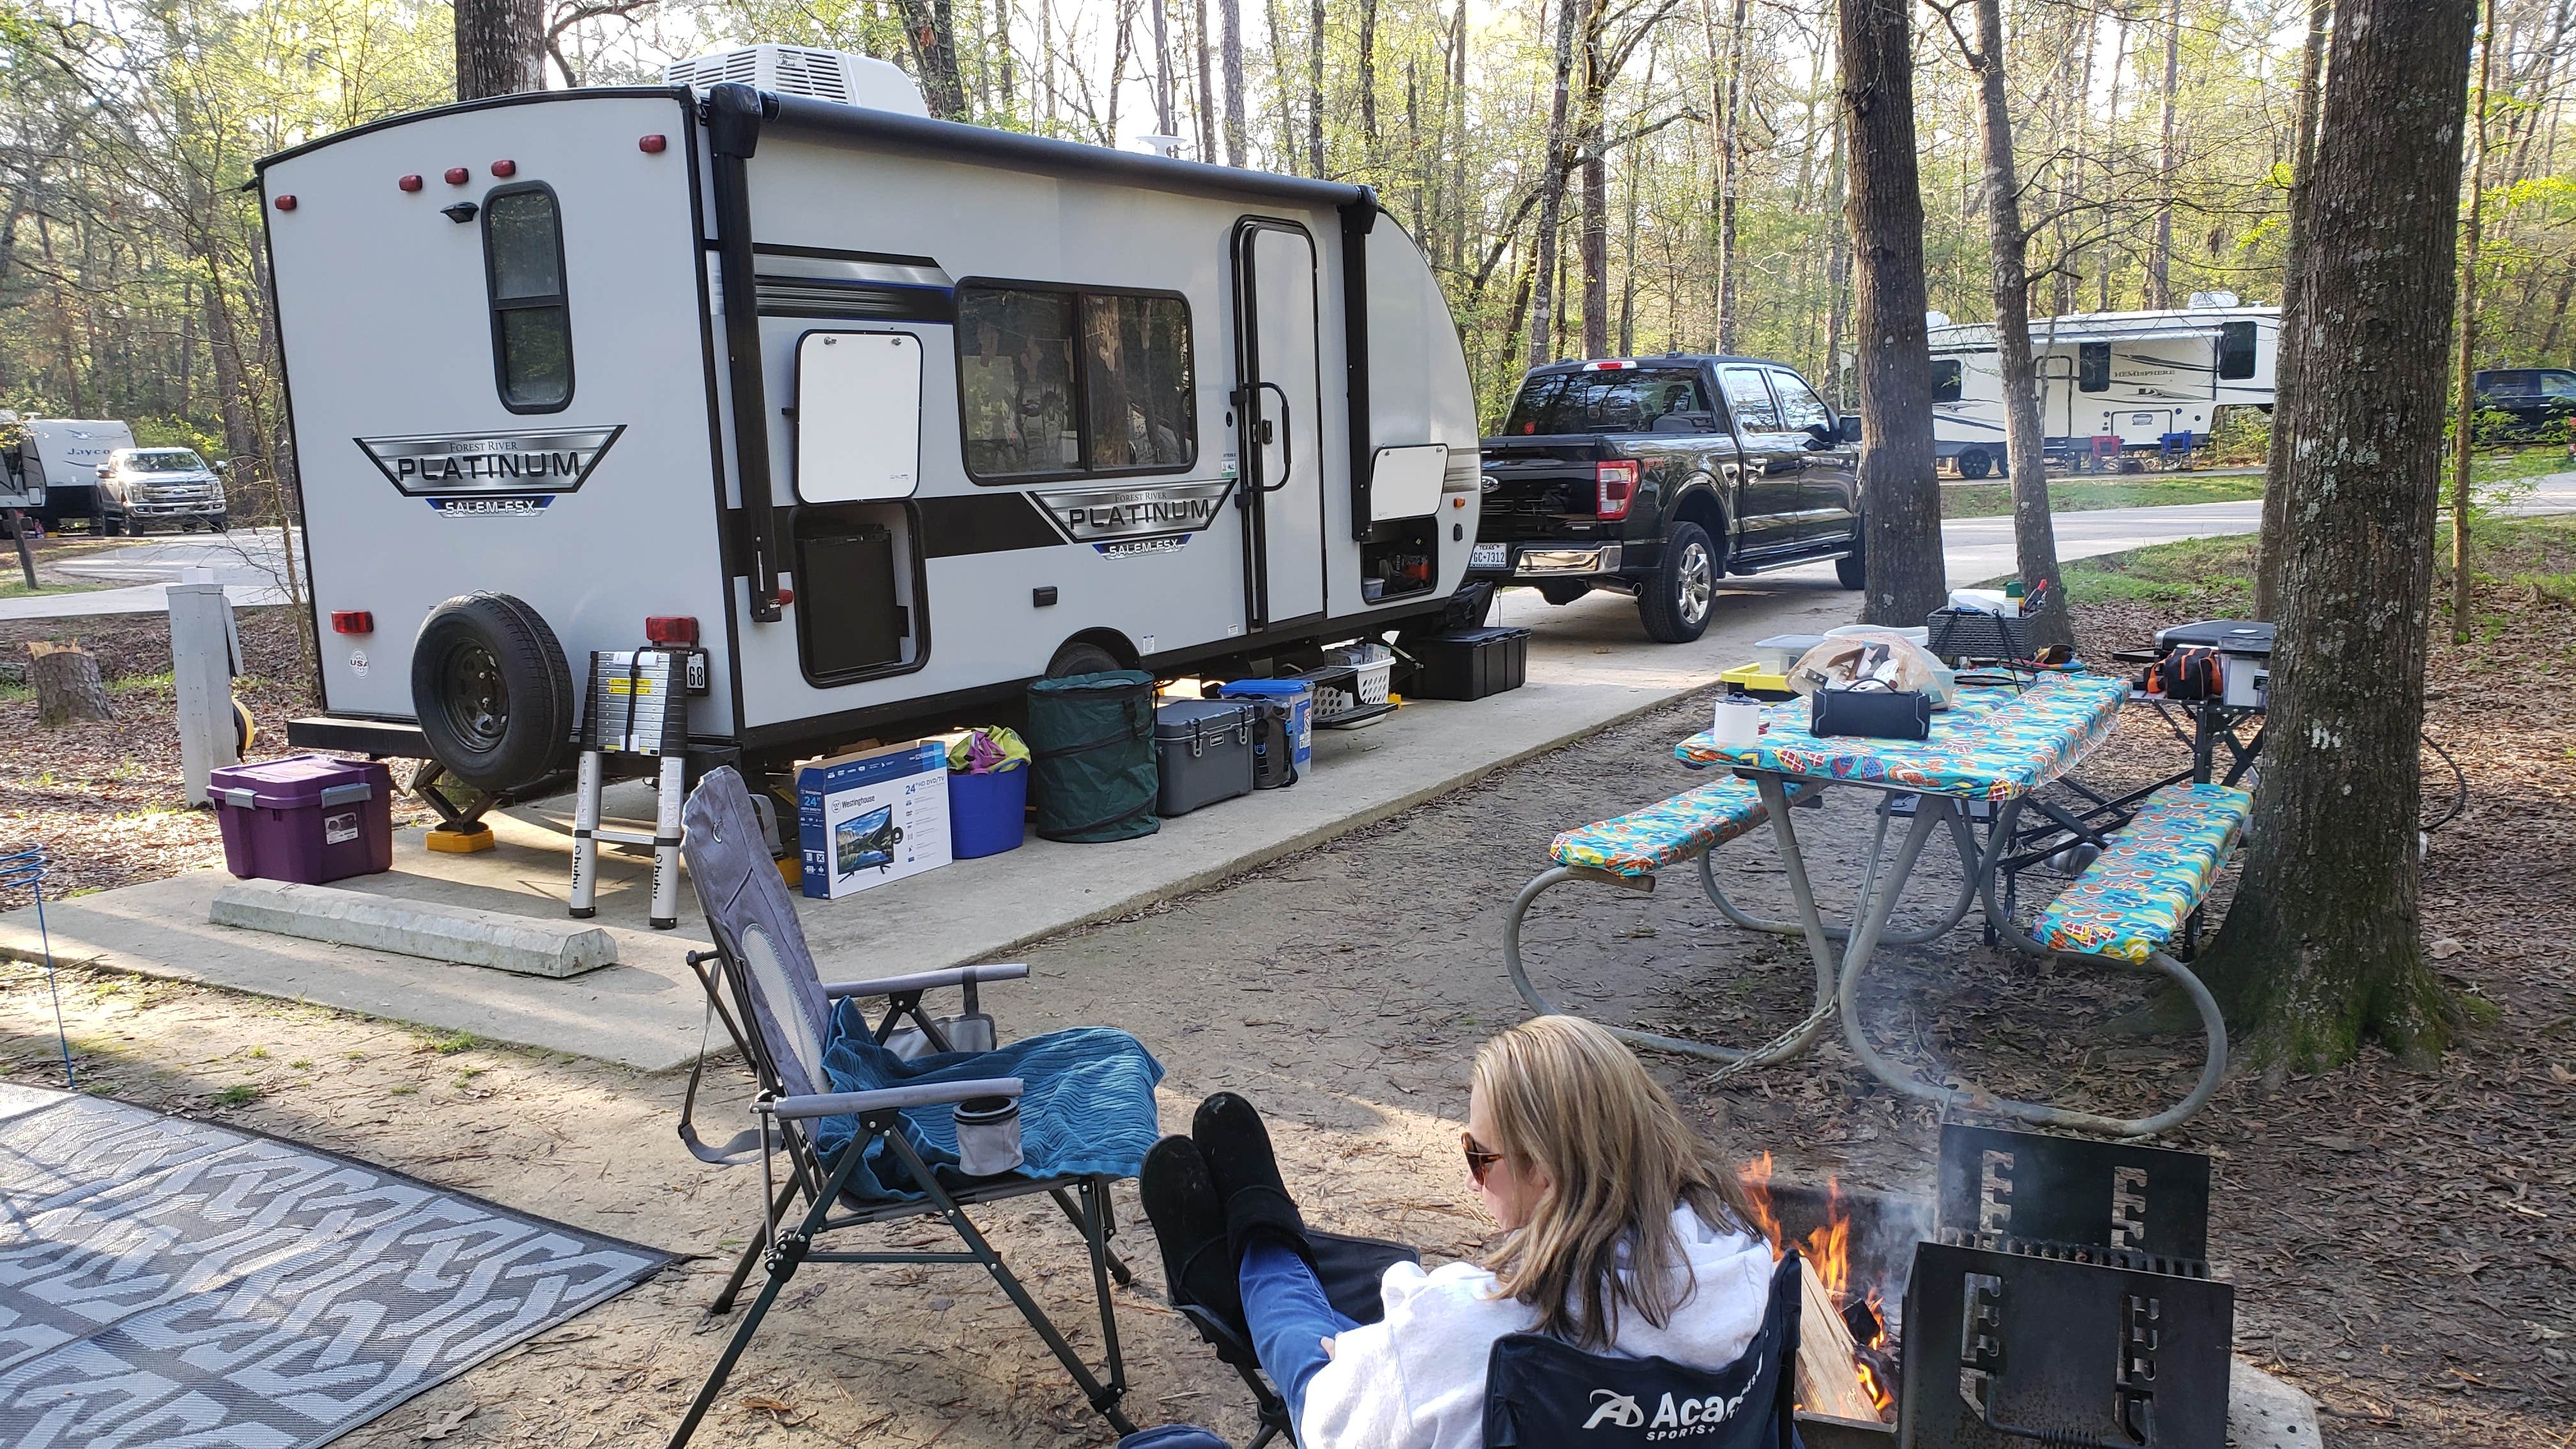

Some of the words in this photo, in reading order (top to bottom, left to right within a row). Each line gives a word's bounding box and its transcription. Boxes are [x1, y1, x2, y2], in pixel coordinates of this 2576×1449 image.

[449, 442, 486, 452] FOREST
[487, 441, 518, 450] RIVER
[397, 452, 579, 481] PLATINUM
[1115, 493, 1144, 503] FOREST
[1145, 492, 1167, 500] RIVER
[445, 501, 498, 515] SALEM
[504, 500, 537, 514] FSX
[1069, 498, 1209, 530] PLATINUM
[1108, 542, 1153, 557] SALEM
[1156, 539, 1179, 551] FSX
[841, 795, 875, 808] Westinghouse
